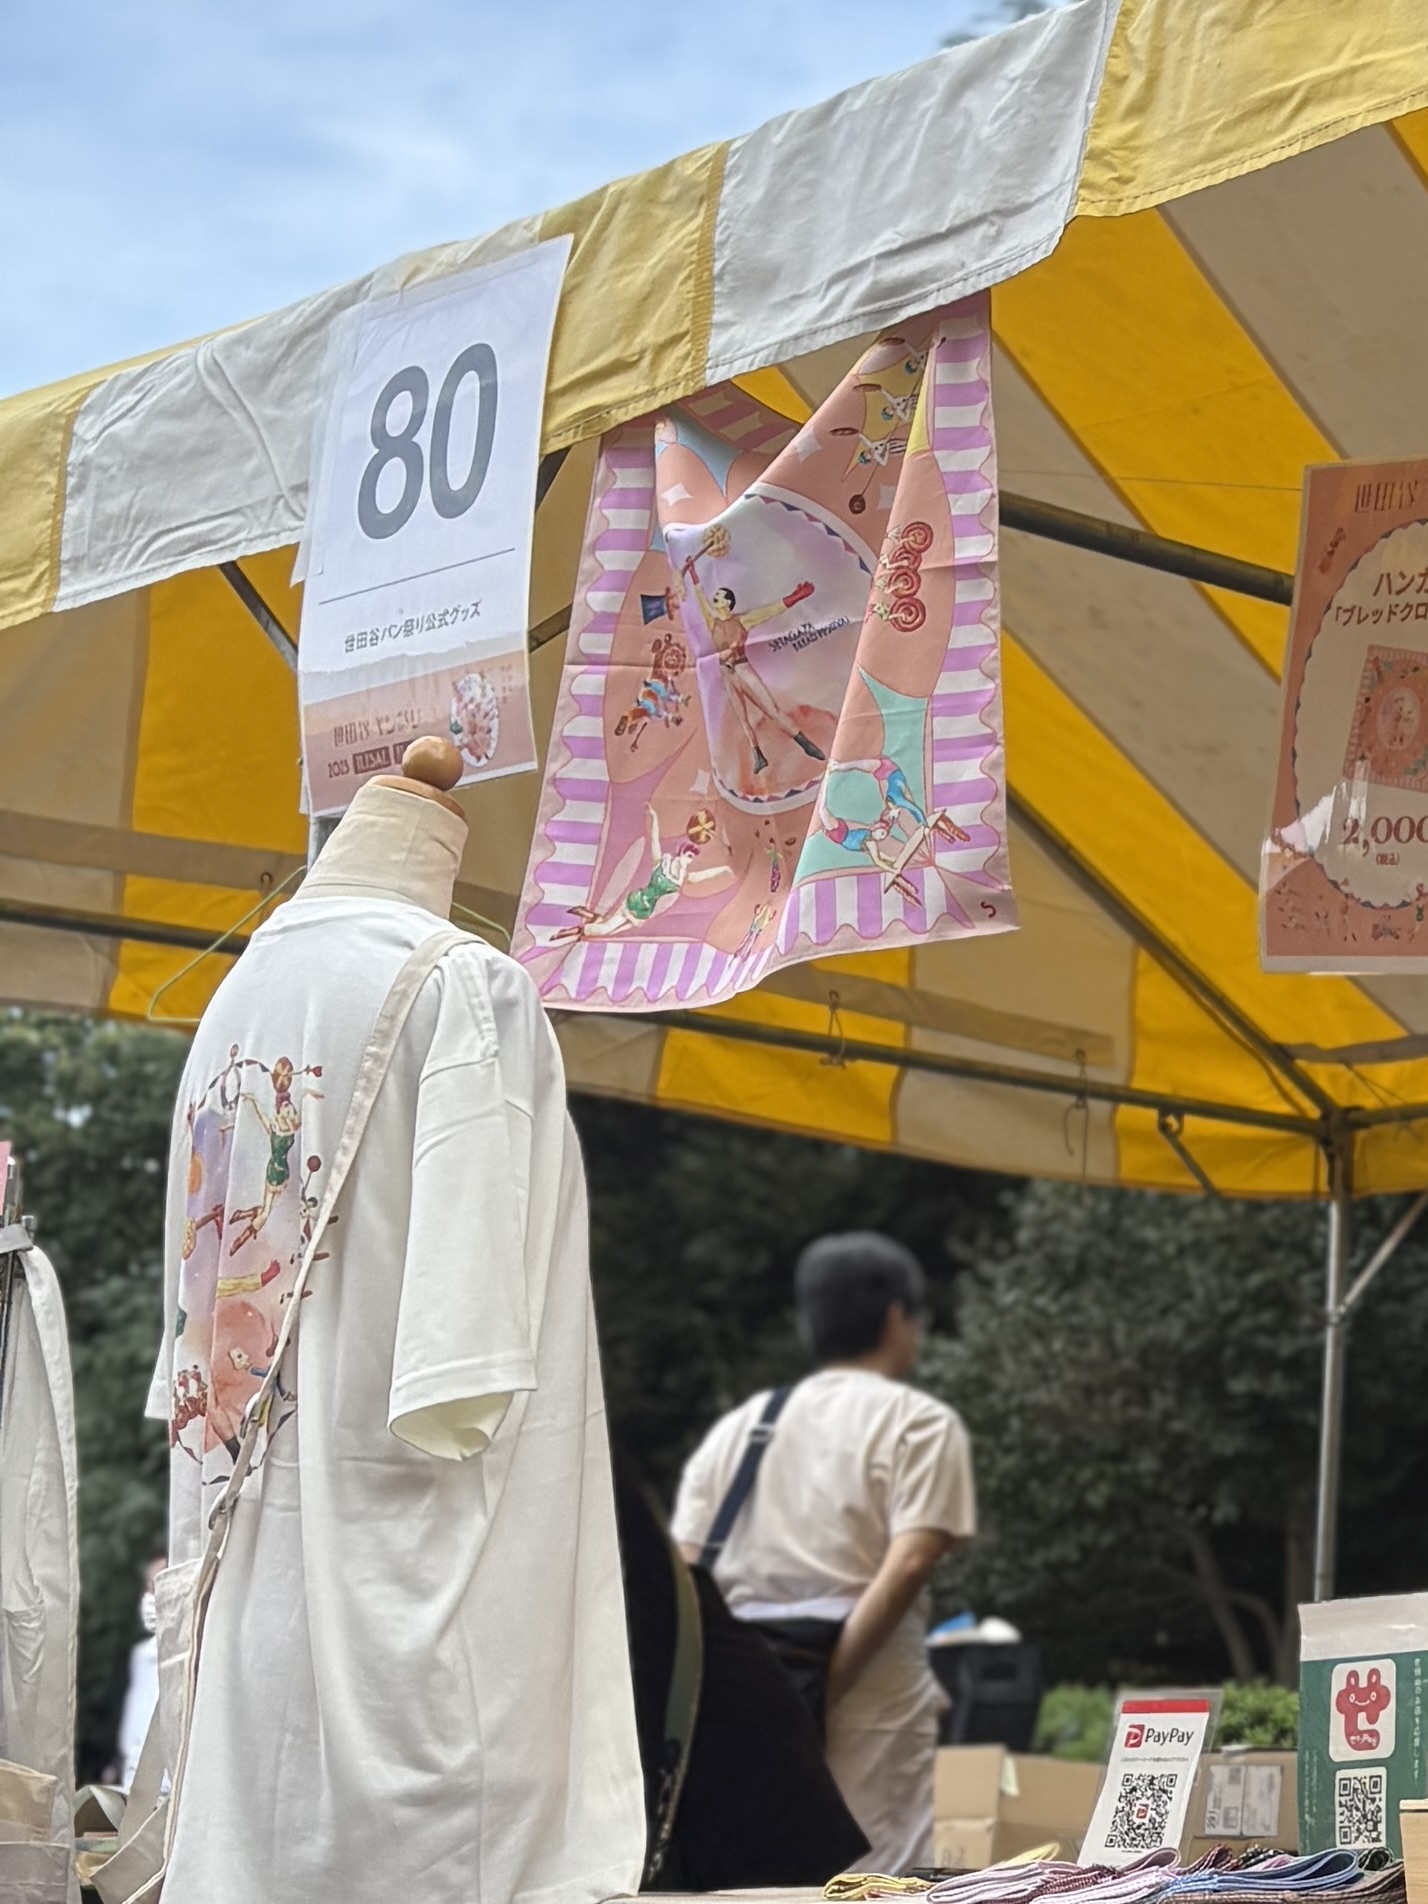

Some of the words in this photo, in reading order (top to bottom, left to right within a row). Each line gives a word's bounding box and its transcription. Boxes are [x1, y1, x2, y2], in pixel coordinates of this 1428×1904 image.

[357, 343, 498, 540] 80
[345, 599, 481, 653] 世田谷パン祭り公式グッズ
[1145, 1727, 1195, 1746] PayPay
